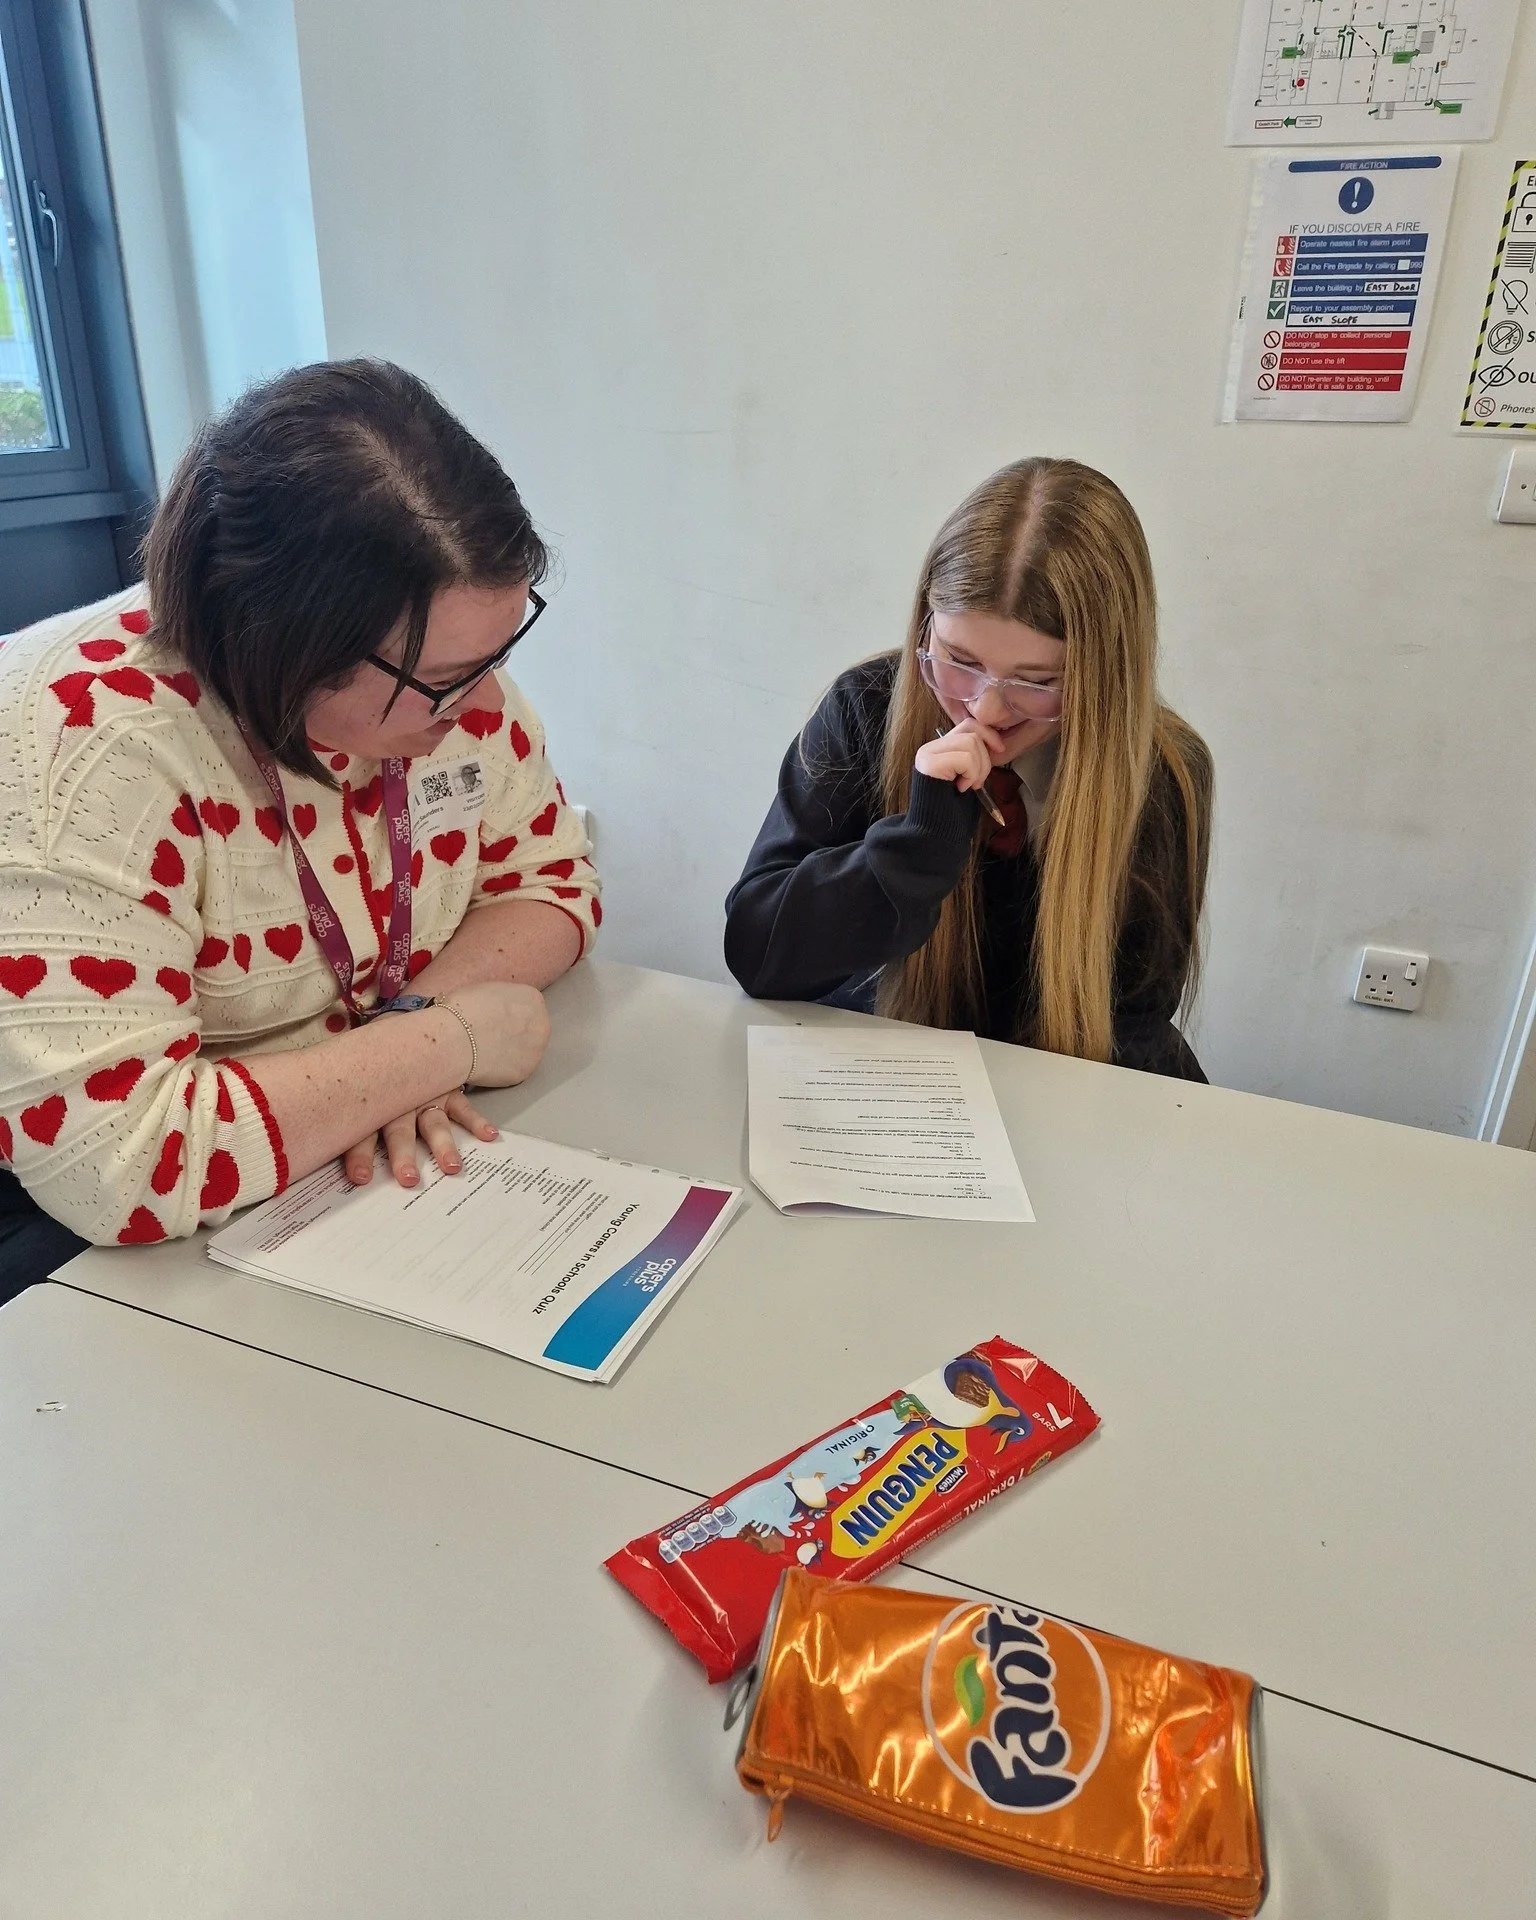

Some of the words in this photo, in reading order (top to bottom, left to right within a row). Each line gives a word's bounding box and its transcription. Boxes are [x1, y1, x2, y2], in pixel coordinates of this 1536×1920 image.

[1359, 161, 1388, 170] ACTION
[1289, 224, 1299, 235] IF
[1302, 223, 1325, 235] YOU
[1327, 222, 1382, 234] DISCOVER
[1385, 222, 1393, 233] A
[1395, 221, 1421, 232] FIRE
[1300, 240, 1327, 248] Operate
[1357, 239, 1368, 247] fire
[1391, 239, 1411, 247] point
[1323, 262, 1336, 270] Fire
[1337, 262, 1363, 271] Brigade
[1365, 262, 1373, 271] by
[1375, 261, 1396, 270] calling
[1293, 284, 1312, 293] Leave
[1314, 284, 1326, 292] the
[1327, 284, 1352, 293] building
[1355, 284, 1364, 293] by
[1365, 283, 1388, 292] EAST
[1290, 304, 1313, 313] Report
[1324, 305, 1339, 313] your
[1341, 304, 1374, 313] assembly
[1375, 304, 1394, 312] point
[1284, 341, 1320, 349] belongings
[1286, 332, 1297, 340] DO
[1314, 332, 1328, 340] stop
[1363, 332, 1392, 340] personal
[1527, 331, 1536, 343] S
[1337, 357, 1346, 365] lift
[1500, 404, 1535, 414] Phones
[392, 817, 404, 841] plus
[401, 808, 411, 845] carers
[397, 881, 405, 903] plus
[308, 903, 327, 938] carers
[318, 906, 336, 933] plus
[393, 940, 402, 961] plus
[401, 933, 410, 966] carers
[610, 1202, 640, 1227] Young
[588, 1226, 618, 1254] Carers
[581, 1252, 596, 1263] in
[551, 1260, 586, 1295] Schools
[634, 1260, 661, 1286] plus
[642, 1258, 677, 1293] carers
[532, 1294, 556, 1315] Quiz
[1031, 1411, 1057, 1433] BARS
[825, 1424, 875, 1455] ORIGINAL
[839, 1430, 961, 1548] PENGUIN
[963, 1475, 1016, 1516] ORIGINAL
